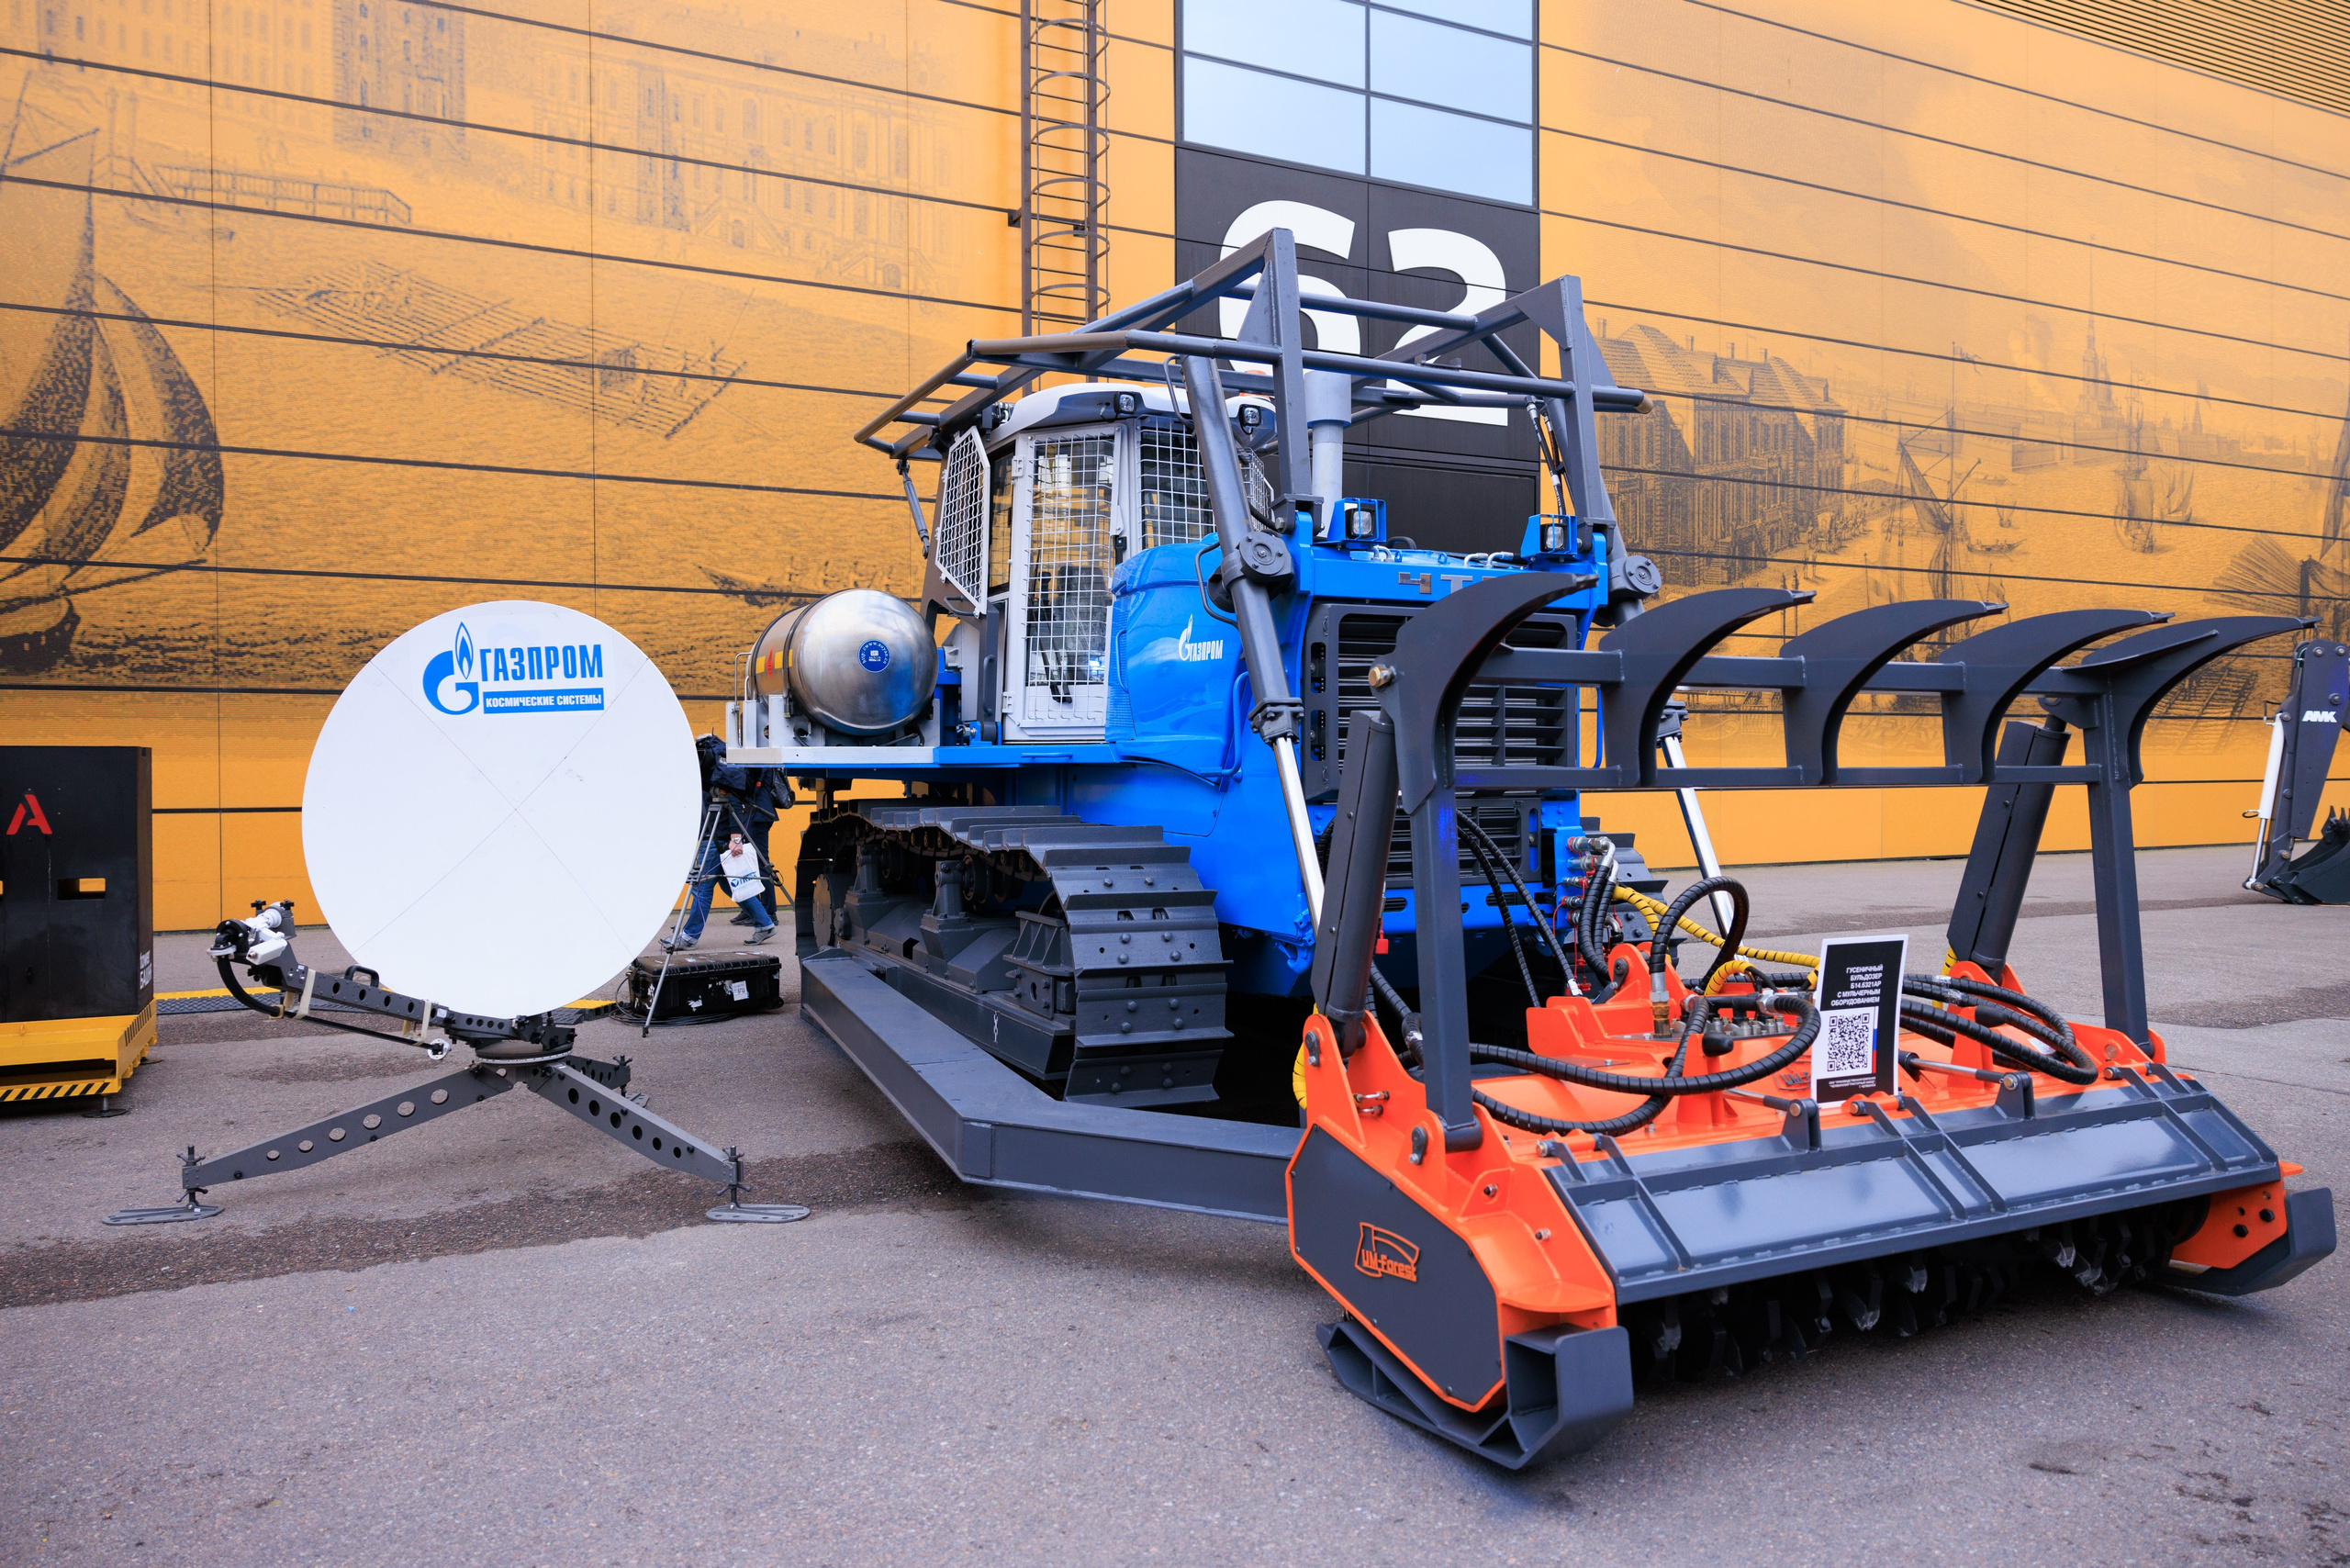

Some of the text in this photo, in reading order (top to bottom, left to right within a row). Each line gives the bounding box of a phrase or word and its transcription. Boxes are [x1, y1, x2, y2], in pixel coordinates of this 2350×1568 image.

[1220, 200, 1507, 426] 62
[1398, 571, 1498, 594] ЧТ
[1189, 640, 1224, 662] ГАЗПРОМ
[480, 644, 603, 682] ГАЗПРОМ
[486, 693, 602, 708] КОСМИЧЕСКИЕ СИСТЕМЫ
[1846, 964, 1884, 974] ГУСЕНИЧНЫЙ
[1850, 973, 1883, 981] БУЛЬДОЗЕР
[1830, 996, 1880, 1007] ОБОРУДОВАНИЕМ
[1842, 989, 1881, 998] МУЛЬЧЕРНЫМ
[1362, 1249, 1416, 1282] UM-Forest
